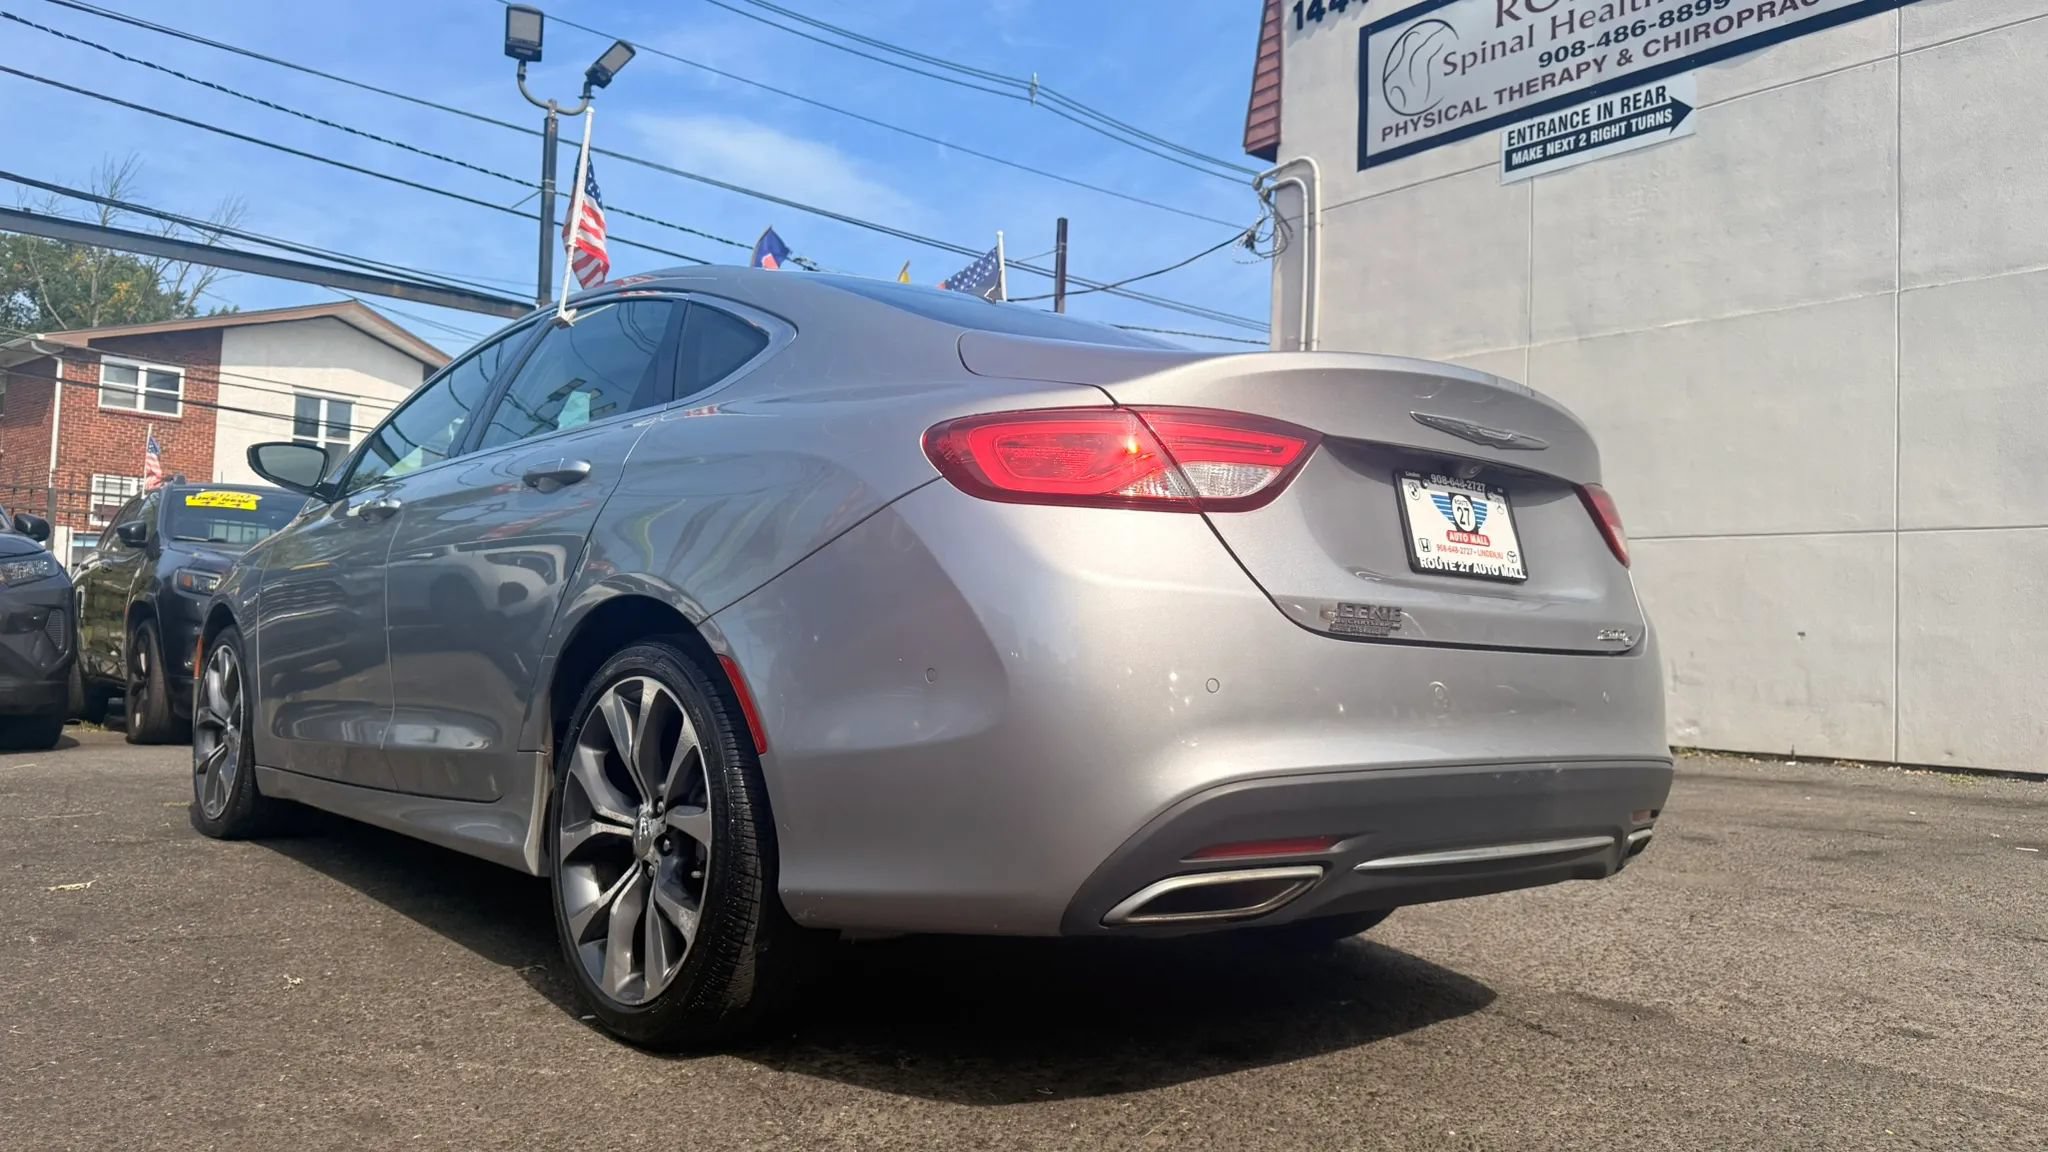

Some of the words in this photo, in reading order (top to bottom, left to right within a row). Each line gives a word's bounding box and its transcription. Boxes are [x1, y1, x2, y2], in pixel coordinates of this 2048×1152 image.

[1443, 24, 1534, 77] Spinal
[1550, 0, 1664, 41] Healt
[1538, 0, 1730, 68] 908-486-8899
[1381, 97, 1487, 142] PHYSICAL
[1494, 54, 1608, 105] THERAPY
[1616, 48, 1633, 67] &
[1508, 108, 1590, 147] ENTRANCE
[1597, 100, 1614, 122] IN
[1620, 85, 1667, 114] REAR
[1511, 145, 1543, 166] MAKE
[1546, 135, 1576, 156] NEXT
[1578, 135, 1587, 147] 2
[1590, 122, 1628, 144] RIGHT
[1629, 108, 1673, 133] TURNS
[1449, 531, 1469, 542] AUTO
[1469, 533, 1489, 546] MALL
[1457, 506, 1470, 526] 27
[1419, 557, 1457, 571] ROUTE
[1458, 562, 1472, 573] 27
[1473, 562, 1499, 576] AUTO
[1500, 565, 1527, 579] MALL
